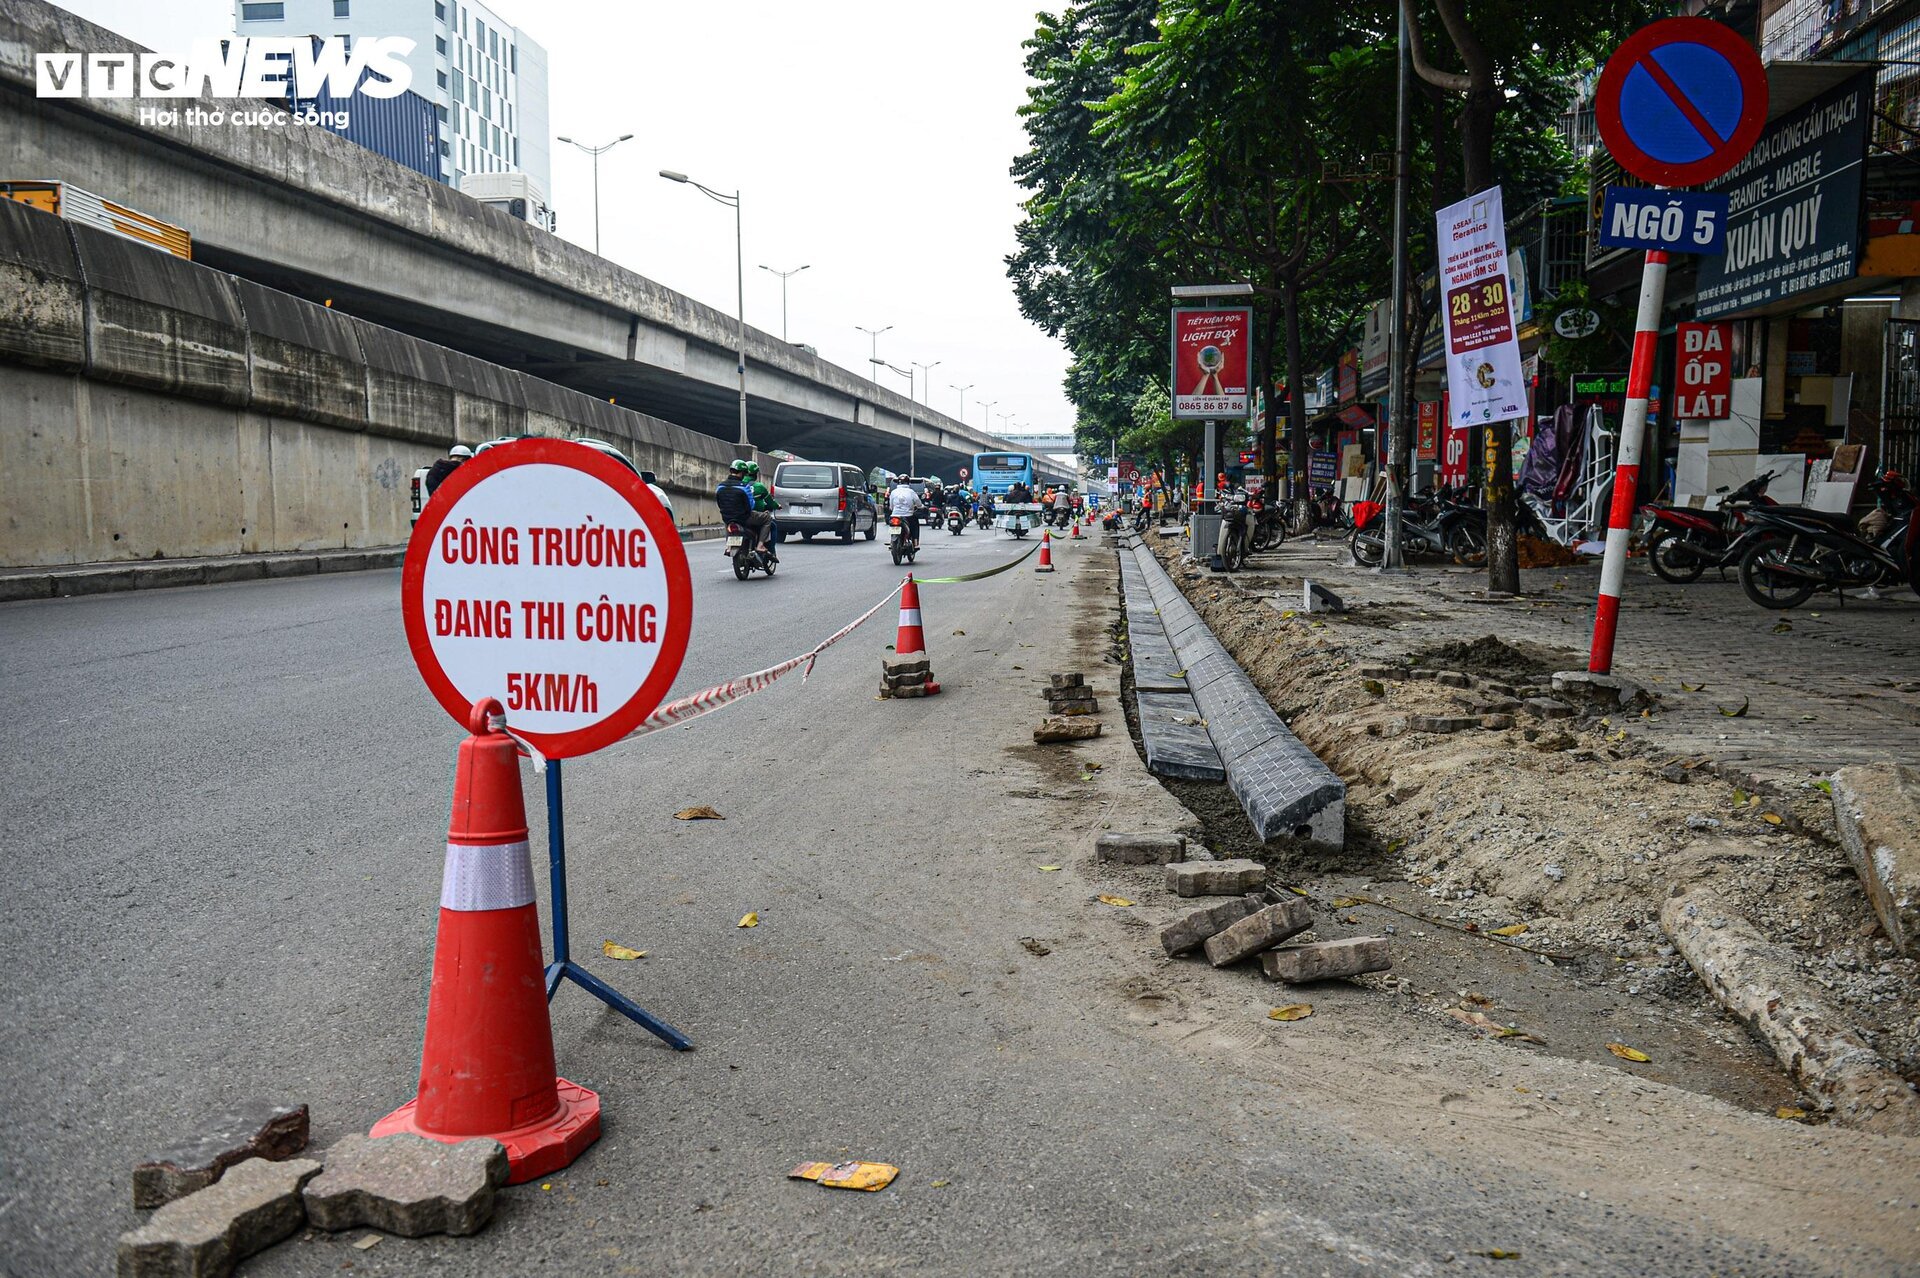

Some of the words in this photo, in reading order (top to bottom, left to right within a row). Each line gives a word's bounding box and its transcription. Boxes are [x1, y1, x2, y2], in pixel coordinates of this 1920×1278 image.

[1753, 140, 1770, 167] HOA
[1825, 91, 1858, 133] THẠCH
[1776, 151, 1822, 193] MARBLE
[1611, 200, 1684, 242] NGÕ
[1693, 210, 1716, 244] 5
[1724, 211, 1775, 274] XUÂN
[1780, 184, 1822, 259] QUÝ
[1452, 292, 1470, 316] 28
[1483, 283, 1503, 306] 30
[1490, 307, 1505, 316] 2023
[1182, 331, 1214, 342] LIGHT
[1214, 329, 1238, 339] BOX
[1187, 316, 1203, 326] TIẾT
[1203, 315, 1223, 325] KIỆM
[1685, 325, 1722, 352] ĐÁ
[1575, 377, 1608, 393] THIẾT
[1610, 376, 1627, 393] KẾ
[1684, 355, 1721, 385] ỐP
[1179, 402, 1201, 410] 0865
[1204, 402, 1215, 410] 86
[1217, 402, 1229, 410] 87
[1231, 402, 1243, 410] 86
[1678, 391, 1727, 417] LÁT
[1447, 431, 1464, 465] ỐP
[442, 518, 519, 565] CÔNG
[528, 515, 647, 568] TRƯỜNG
[435, 599, 512, 638] ĐANG
[521, 601, 565, 640] THI
[576, 595, 656, 643] CÔNG
[507, 673, 598, 713] 5KM/h
